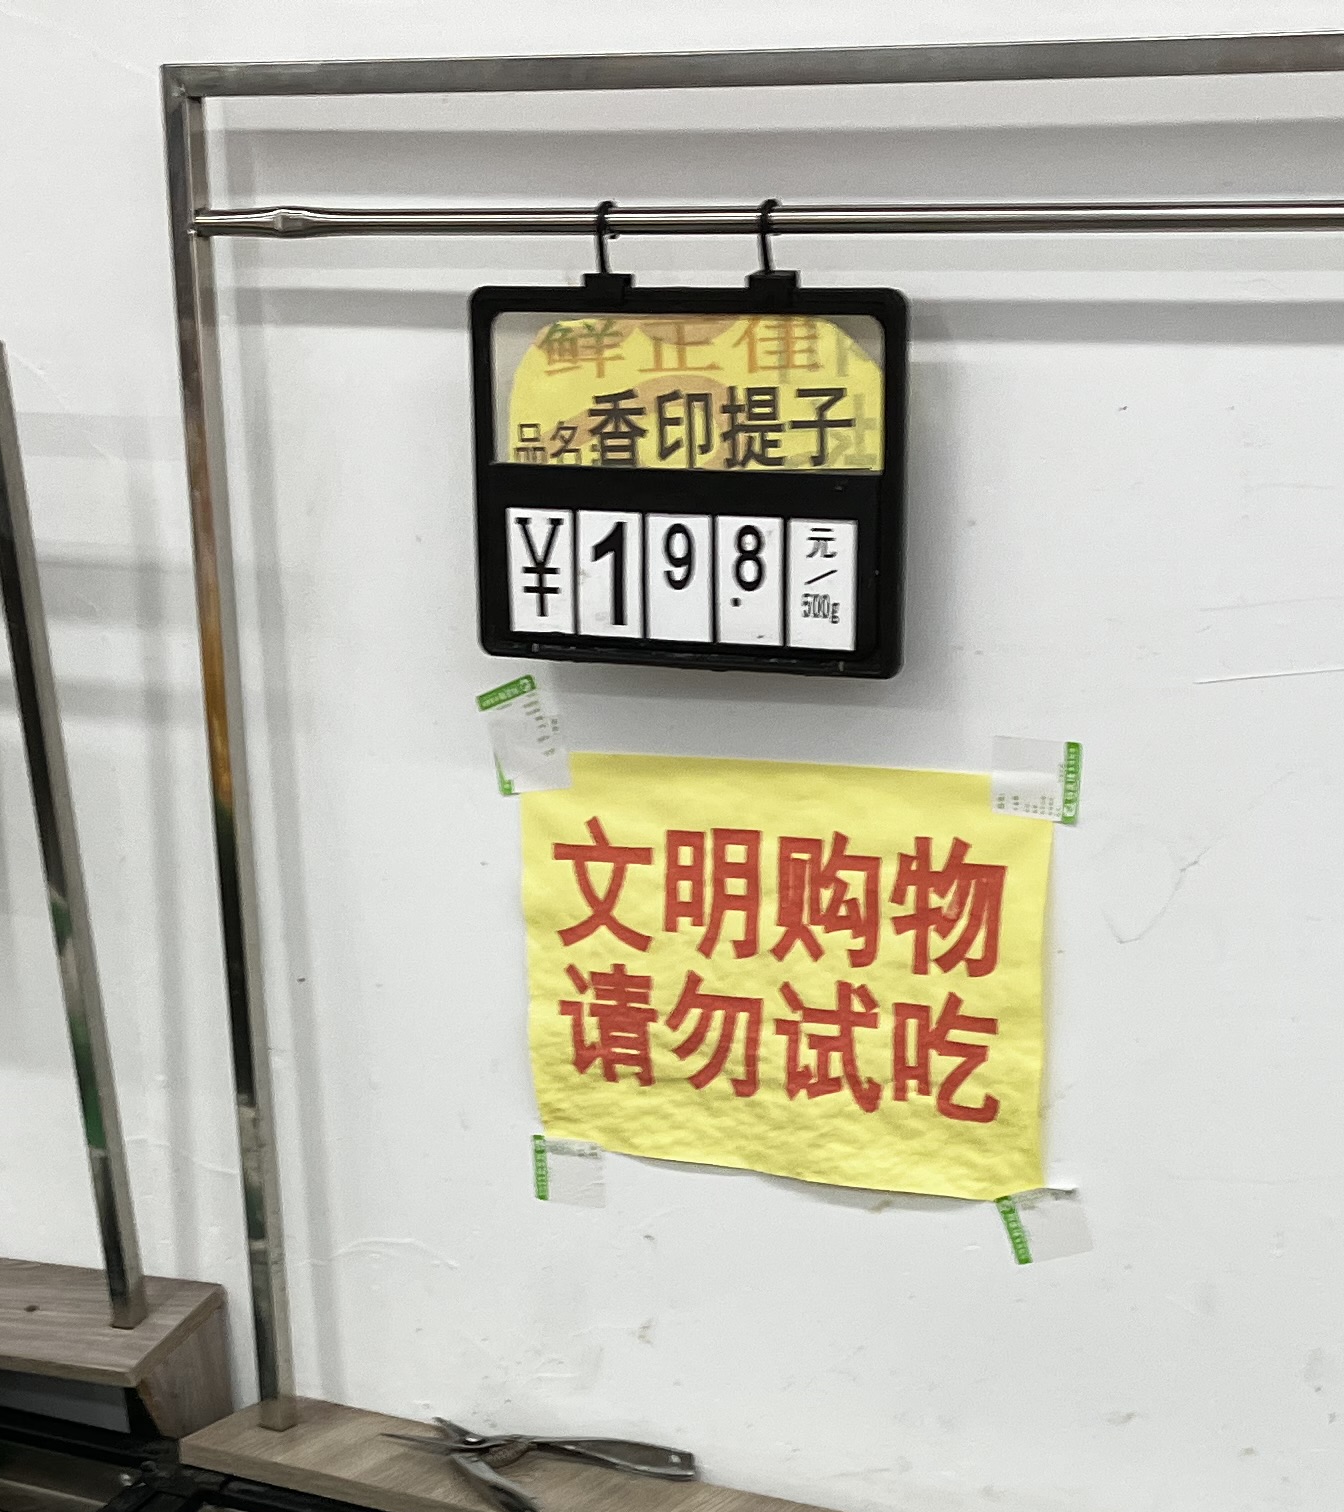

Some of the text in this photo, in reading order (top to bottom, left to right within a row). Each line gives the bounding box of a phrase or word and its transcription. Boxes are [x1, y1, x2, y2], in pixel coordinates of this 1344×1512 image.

[551, 816, 1008, 978] 文明购物
[557, 963, 1002, 1124] 请勿试吃
